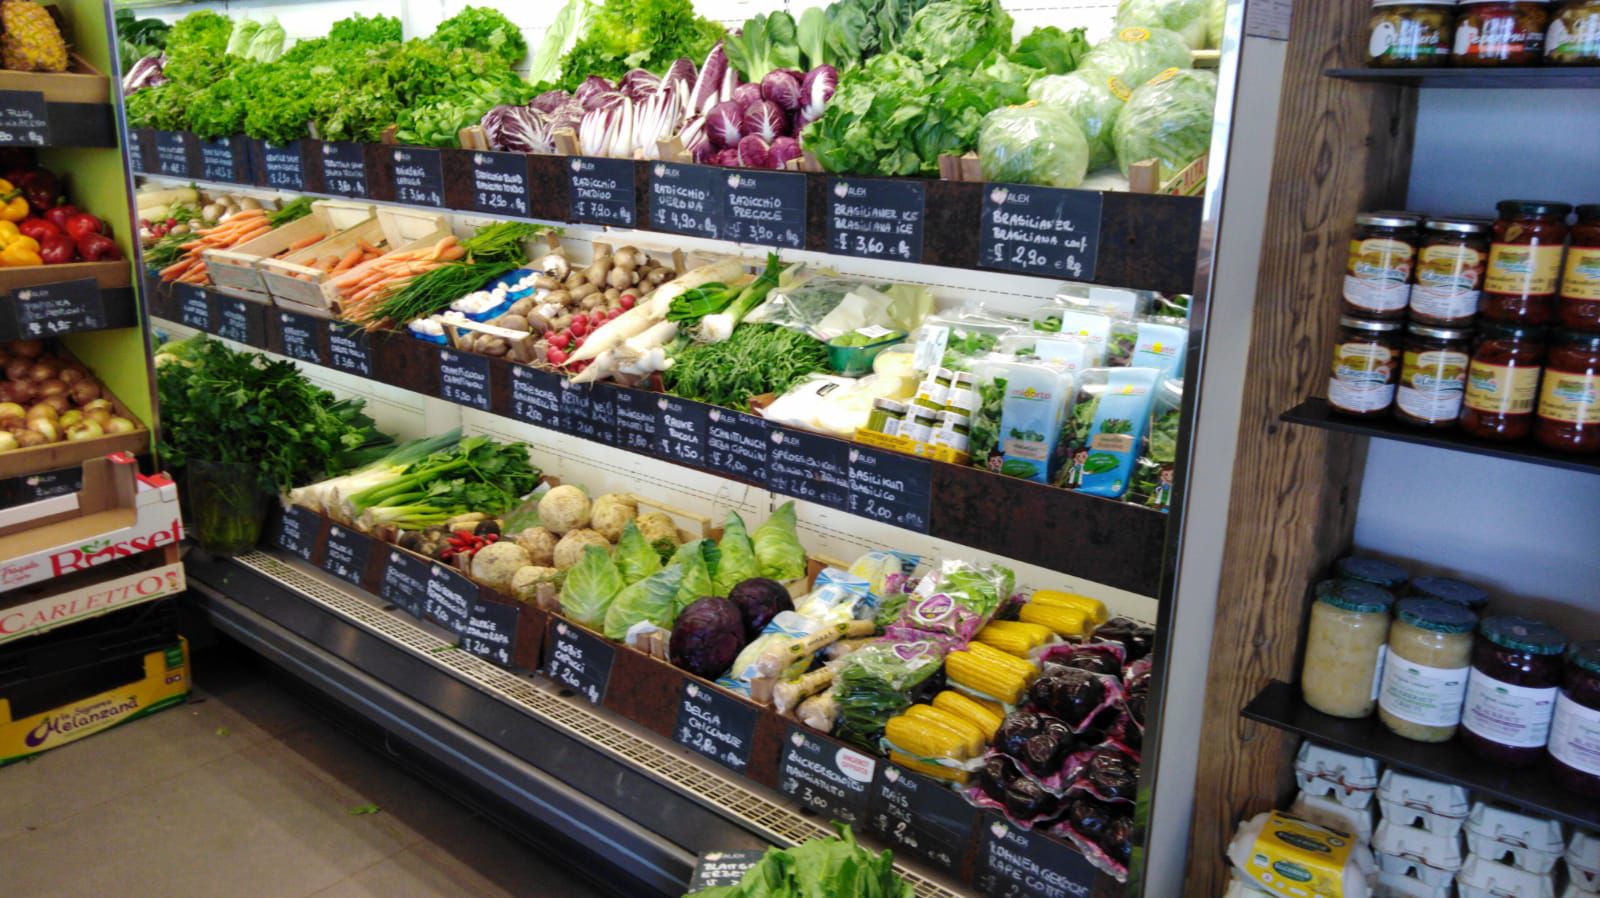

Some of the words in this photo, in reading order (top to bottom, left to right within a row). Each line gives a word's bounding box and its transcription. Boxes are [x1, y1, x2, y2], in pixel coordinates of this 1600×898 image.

[848, 186, 867, 198] ALEX
[1007, 193, 1031, 204] ALEX
[748, 225, 774, 242] 3,90
[855, 235, 885, 255] 3,60
[1011, 245, 1048, 268] 2,90
[674, 441, 698, 459] 1,50
[864, 498, 893, 520] 2,00
[0, 575, 163, 635] CARLETTO
[683, 700, 721, 726] BELGA
[897, 774, 919, 793] ALEX
[801, 786, 829, 809] 3,00
[1005, 830, 1030, 848] ALEX
[988, 854, 1024, 881] RAPE
